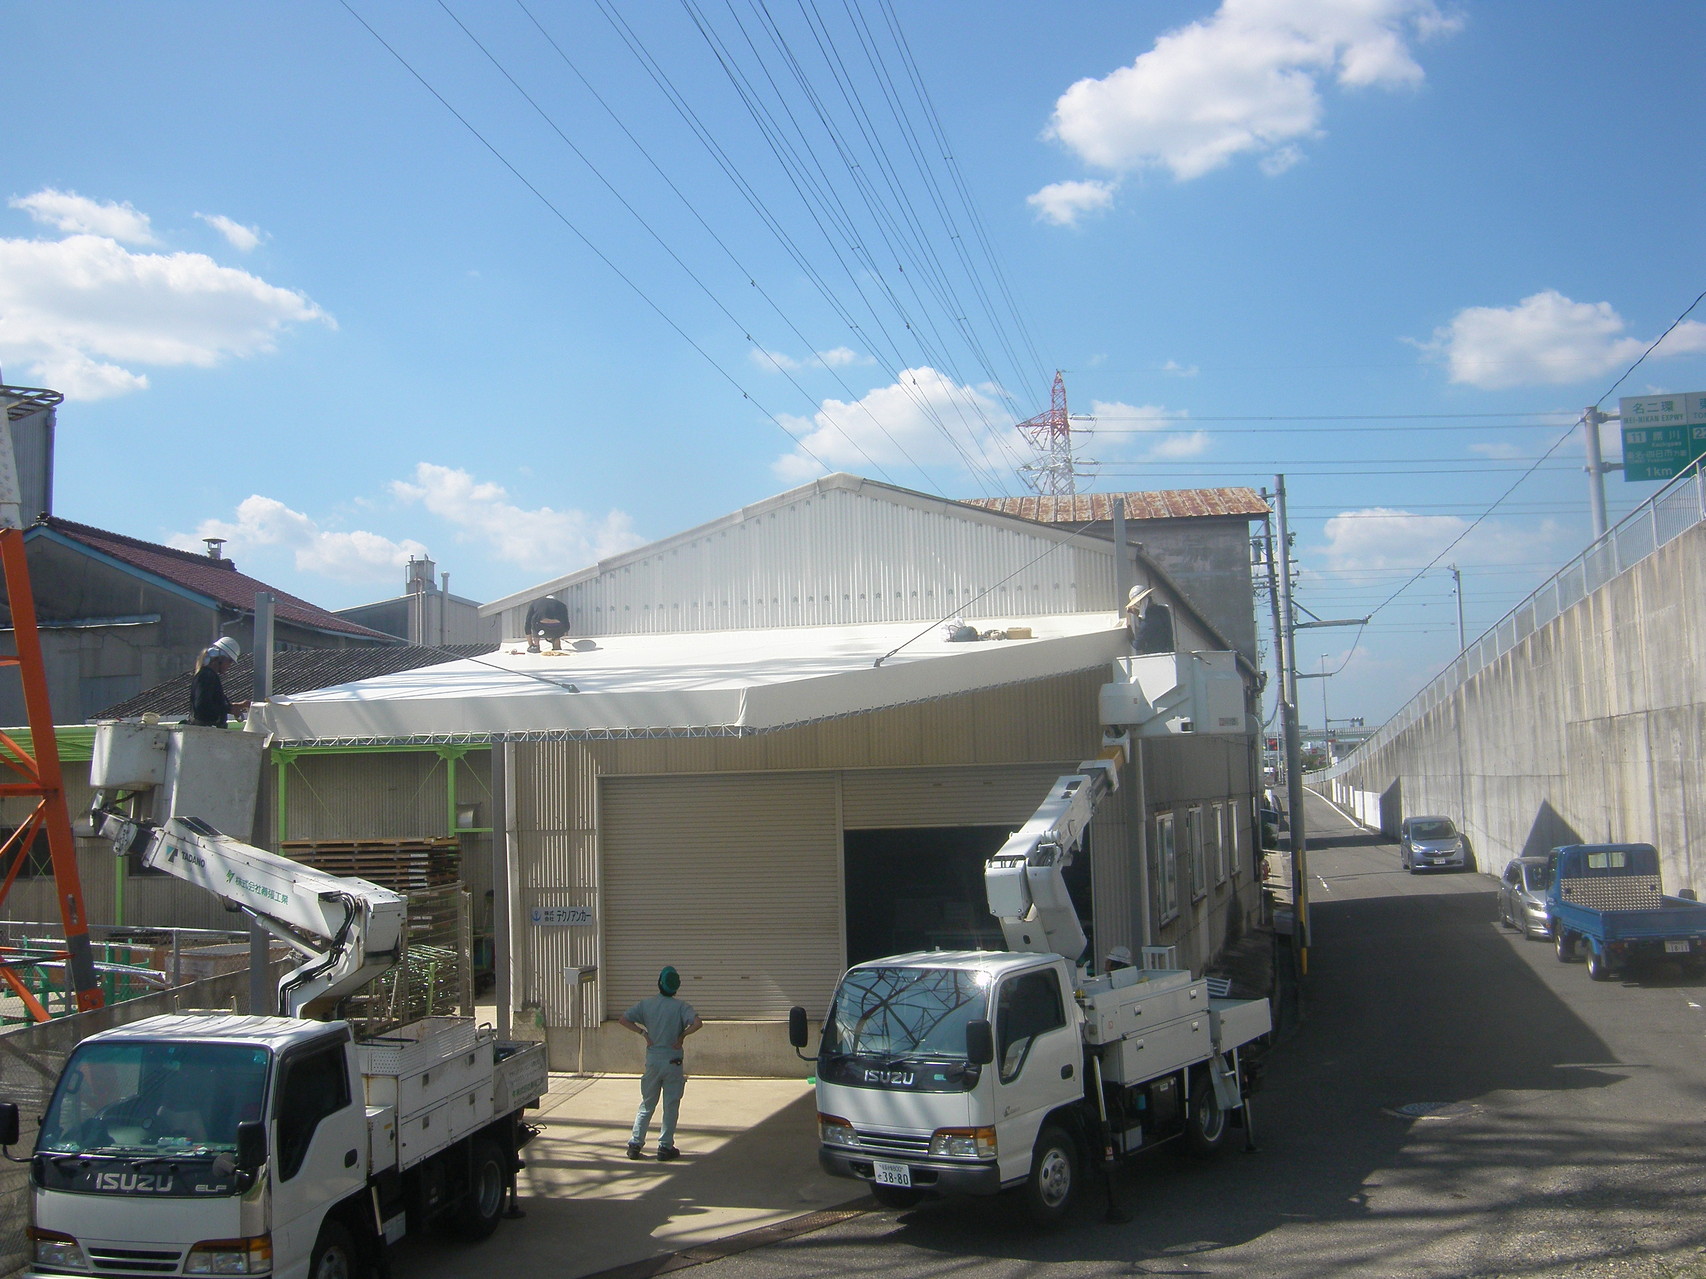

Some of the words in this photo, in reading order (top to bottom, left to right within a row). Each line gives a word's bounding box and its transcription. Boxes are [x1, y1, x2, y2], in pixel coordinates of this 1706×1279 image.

[1633, 401, 1673, 414] 名二環
[1661, 413, 1683, 422] EXPWY
[181, 851, 206, 868] TADANO
[557, 910, 591, 922] テクノアンカー
[864, 1069, 914, 1085] ISUZU
[96, 1172, 174, 1192] ISUZU
[195, 1184, 227, 1193] ELF
[882, 1171, 909, 1185] 38-80
